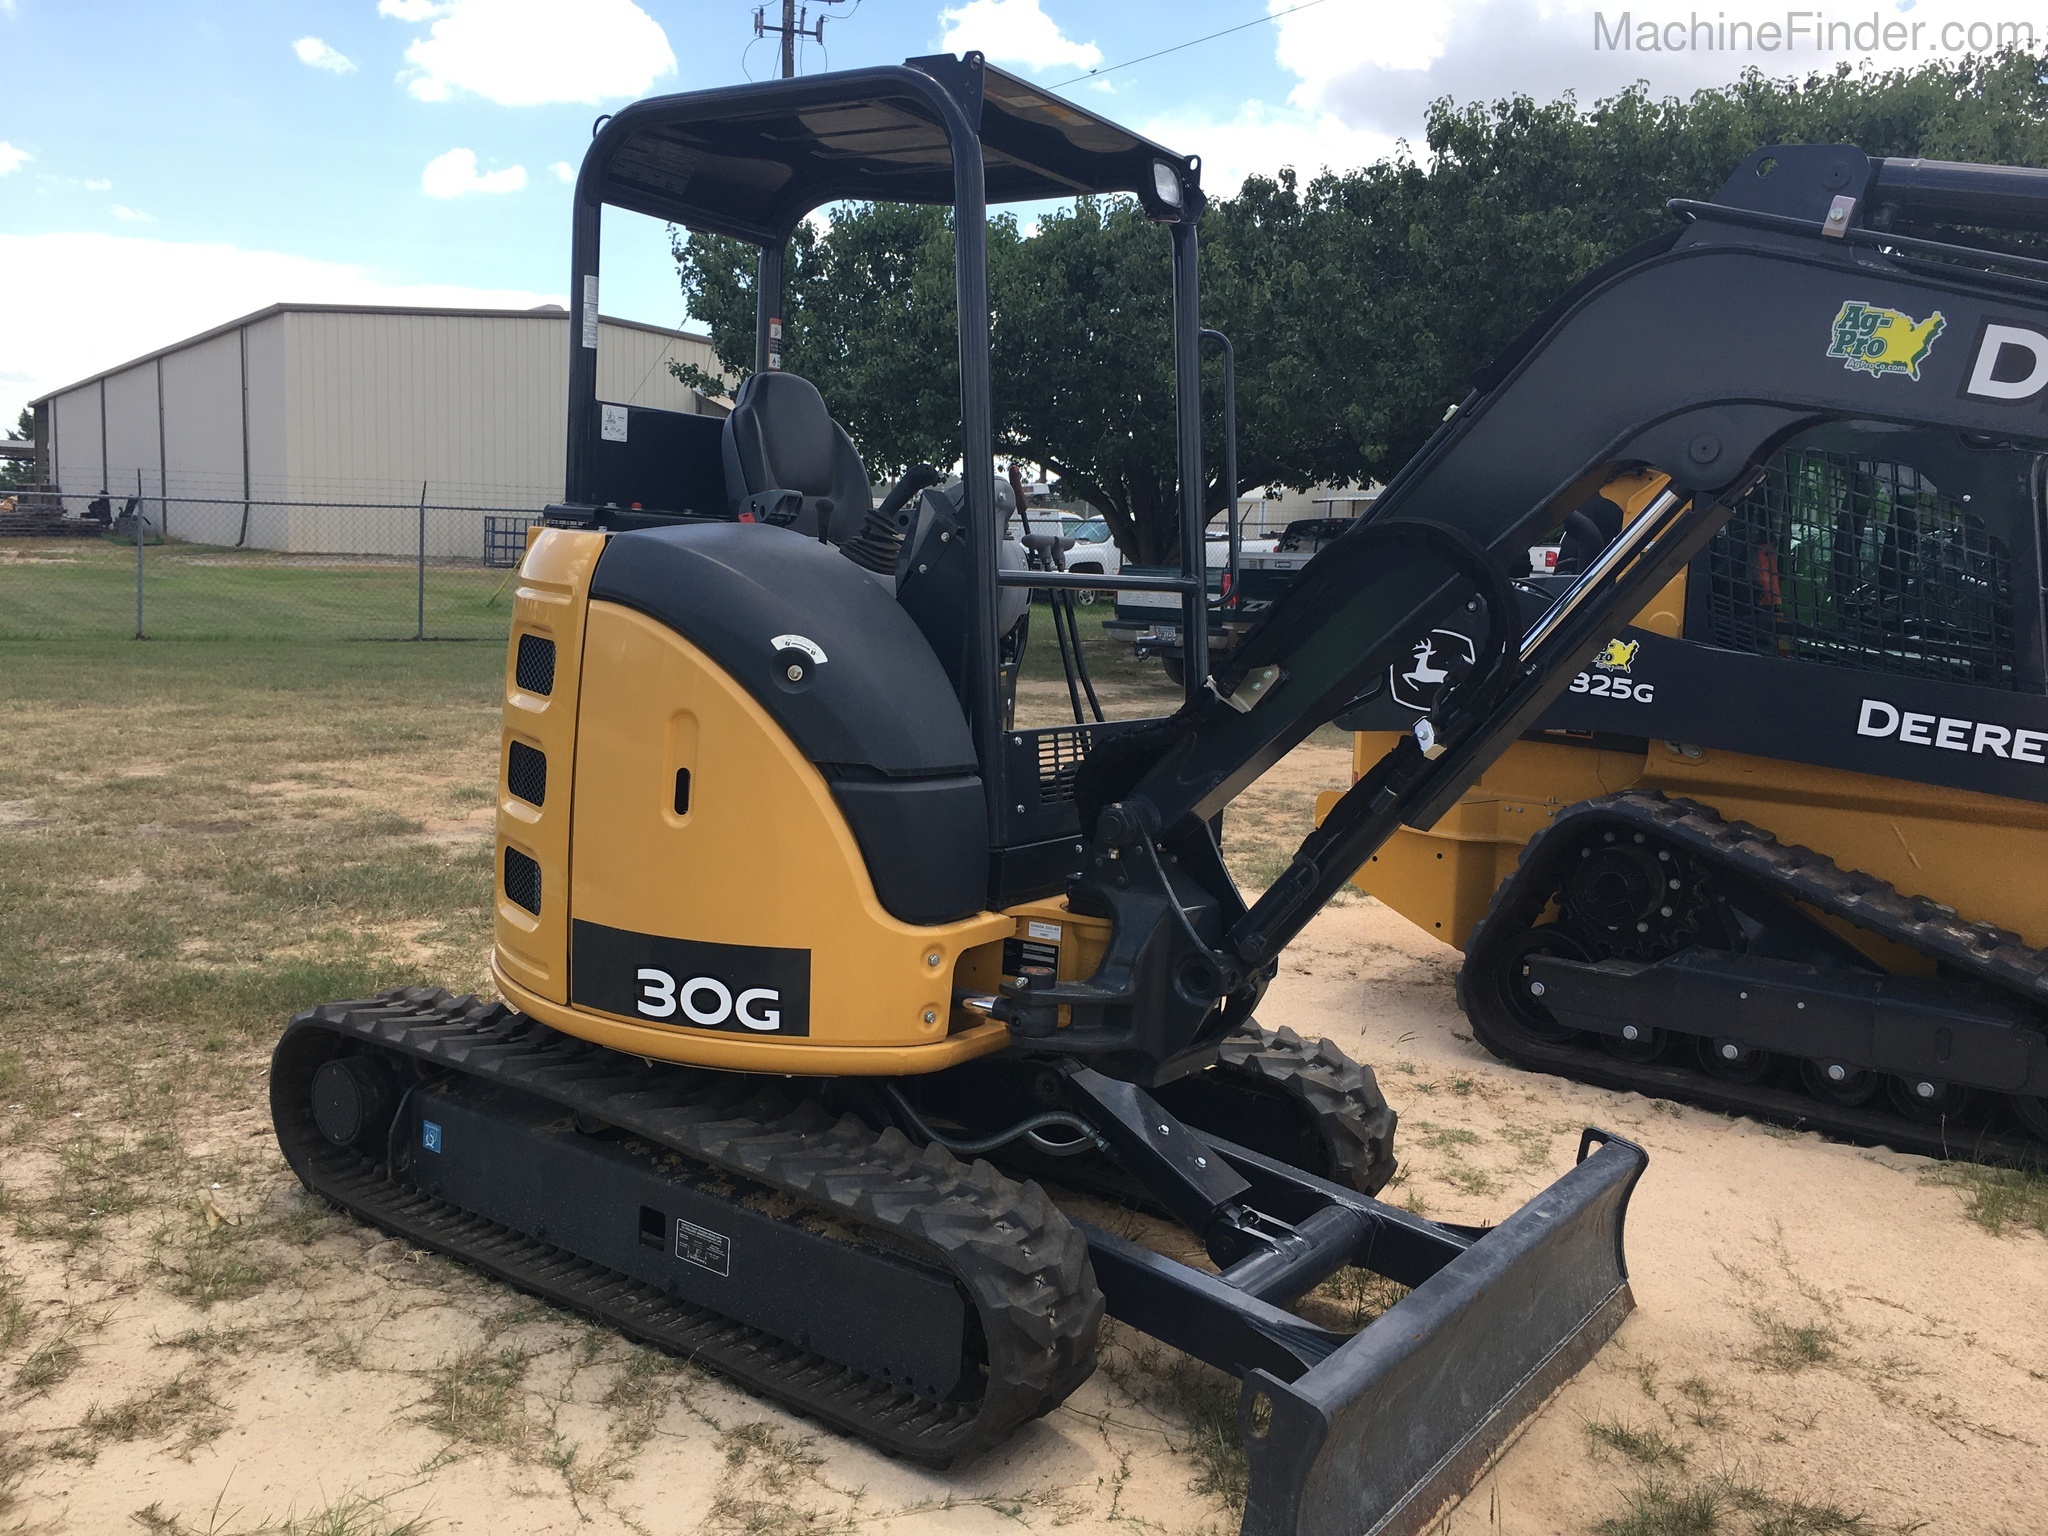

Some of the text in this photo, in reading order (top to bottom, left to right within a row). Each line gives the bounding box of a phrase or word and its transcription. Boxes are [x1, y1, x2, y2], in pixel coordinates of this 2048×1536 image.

[1837, 303, 1893, 336] Ag-
[1829, 329, 1887, 358] Pro
[1848, 359, 1907, 373] AgProCo.com
[1569, 672, 1655, 703] 325G
[1857, 699, 2048, 764] DEERE
[637, 968, 780, 1031] 30G
